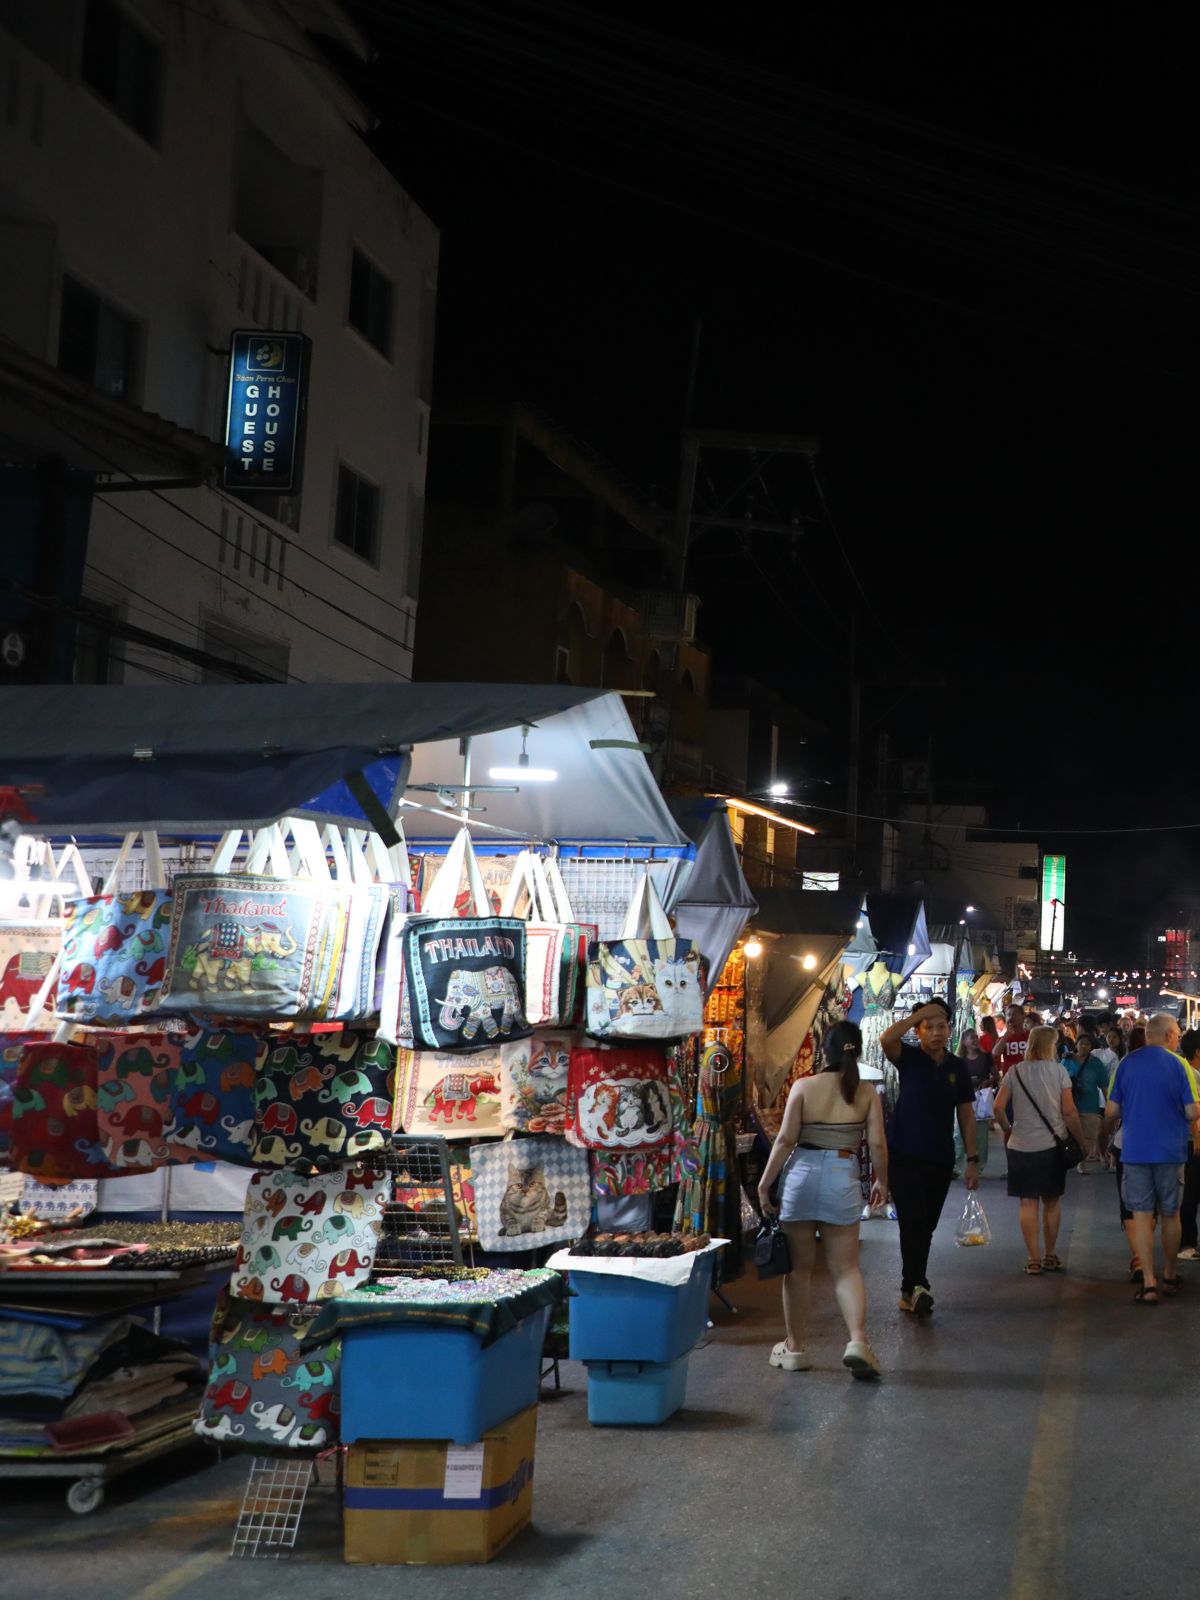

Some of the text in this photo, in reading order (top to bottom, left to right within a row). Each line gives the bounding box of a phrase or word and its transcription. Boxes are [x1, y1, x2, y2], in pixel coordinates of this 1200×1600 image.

[241, 385, 260, 472] GUEST
[262, 385, 281, 472] HOUSE
[198, 894, 289, 918] Thailand
[423, 935, 516, 965] THAILAND
